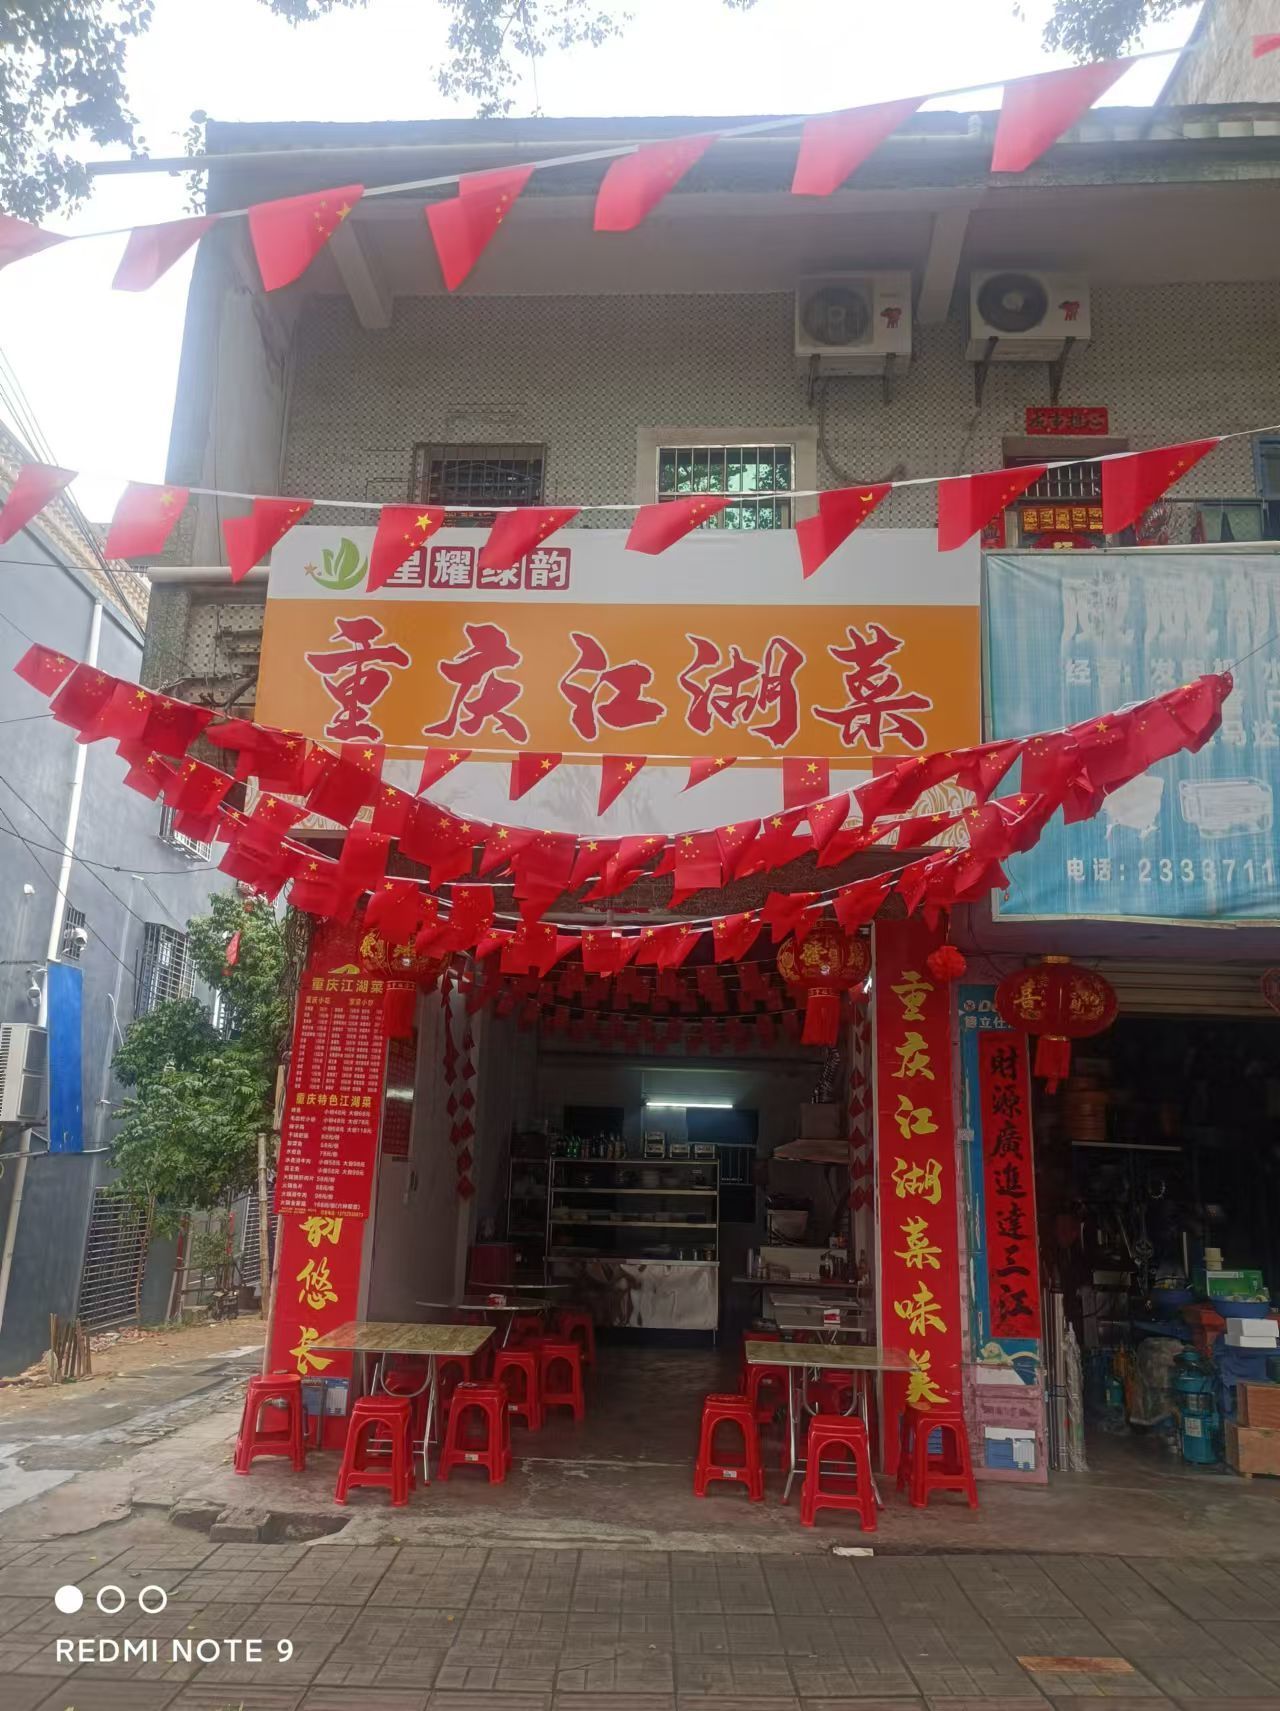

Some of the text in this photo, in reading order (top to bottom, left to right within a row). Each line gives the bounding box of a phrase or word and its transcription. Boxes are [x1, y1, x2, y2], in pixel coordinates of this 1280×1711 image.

[304, 616, 933, 751] 重庆江湖菜
[312, 977, 384, 993] 重庆江湖菜
[296, 1093, 372, 1107] 重庆特色江湖菜
[891, 970, 949, 1405] 重庆江湖菜味美
